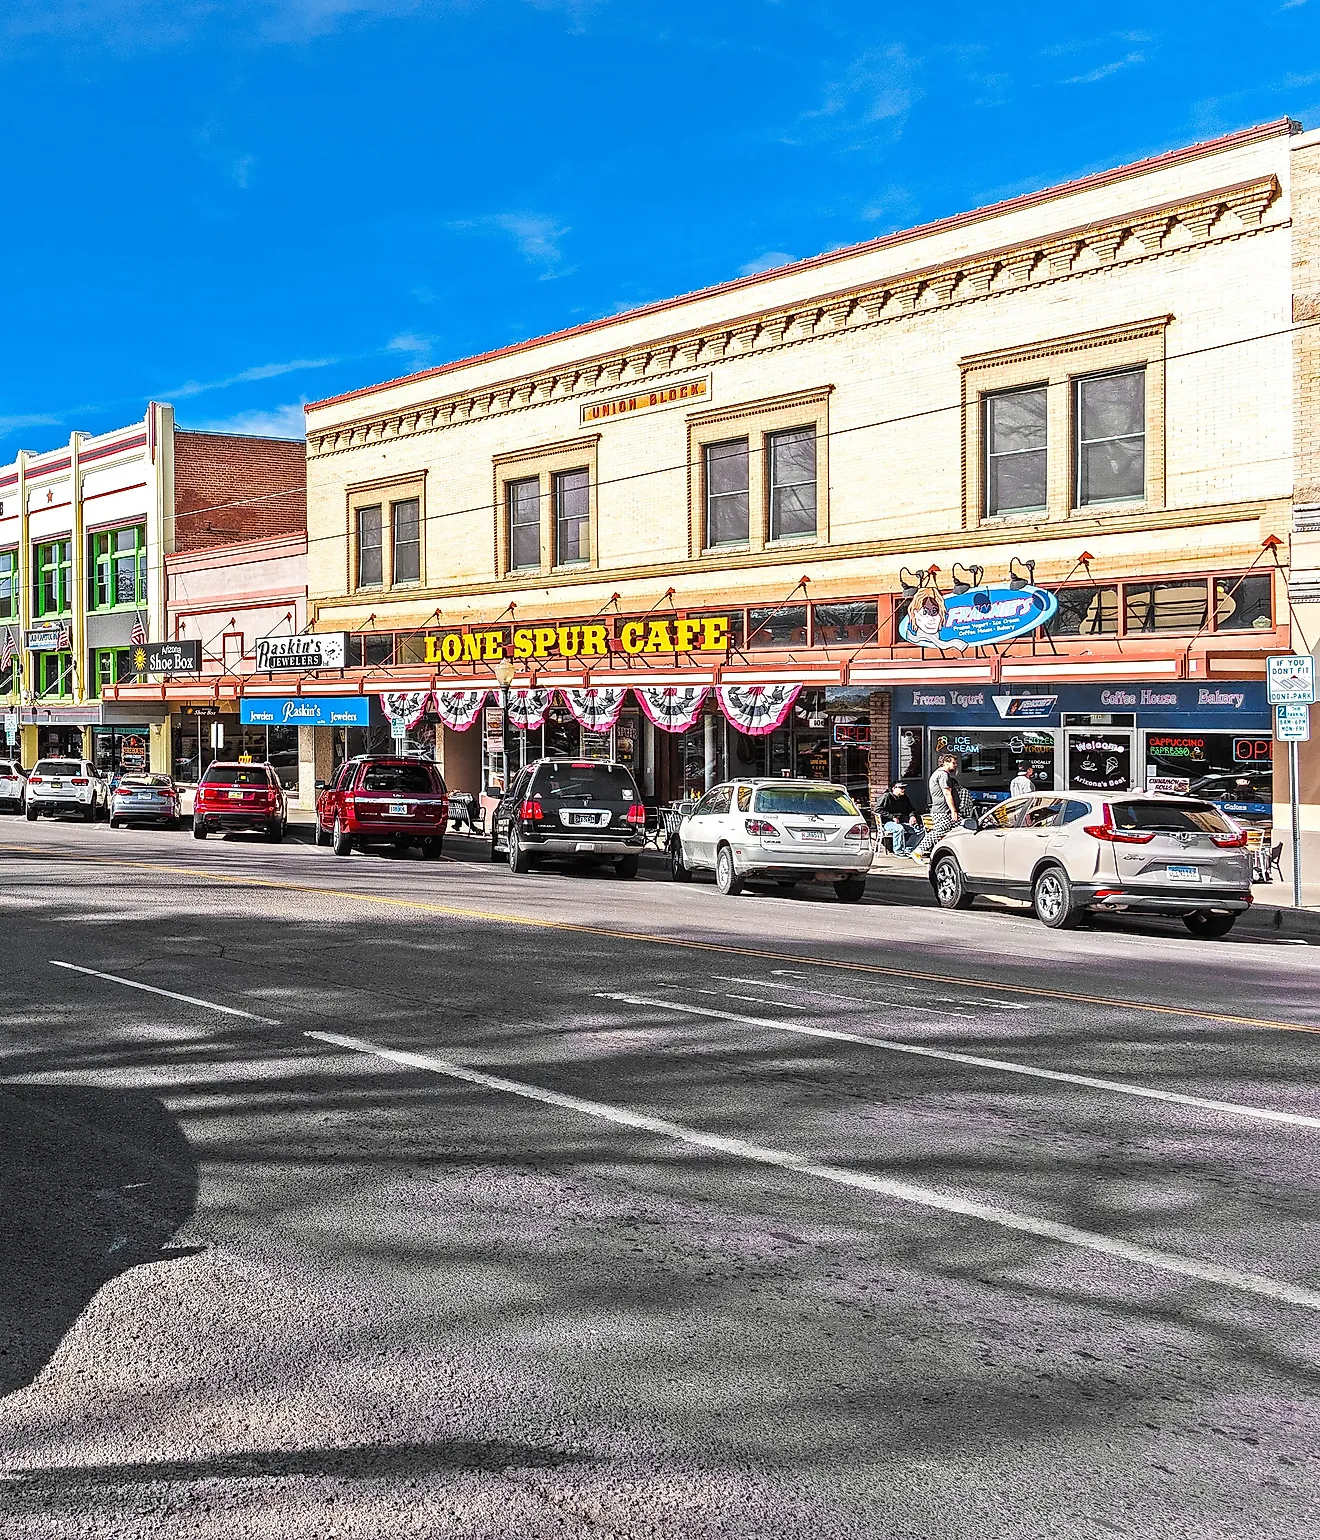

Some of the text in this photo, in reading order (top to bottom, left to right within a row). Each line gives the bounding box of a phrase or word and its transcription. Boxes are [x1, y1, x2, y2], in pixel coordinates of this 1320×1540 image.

[592, 398, 637, 418] UNION
[945, 596, 1034, 629] FRANNIE'S
[424, 616, 730, 663] LONE SPUR CAFE
[161, 645, 182, 655] Arizona
[257, 638, 322, 669] Raskin's
[149, 653, 193, 670] Shoe Box
[270, 655, 319, 668] JEWELERS
[912, 690, 984, 708] Frozen Yogurt
[1100, 689, 1178, 706] Coffee House
[1198, 688, 1245, 708] Bakery
[249, 710, 274, 722] Jewelers
[282, 701, 321, 723] Raskin's
[330, 711, 357, 723] Jewelers
[1280, 707, 1286, 715] 2
[954, 736, 970, 744] ICE
[1076, 740, 1126, 753] Welcome
[1149, 737, 1204, 747] CAPPUCCINO
[946, 744, 979, 753] CREAM
[1150, 746, 1190, 756] ESPRESSO
[1073, 775, 1126, 787] Arizona's Best
[1223, 803, 1248, 811] Cakes
